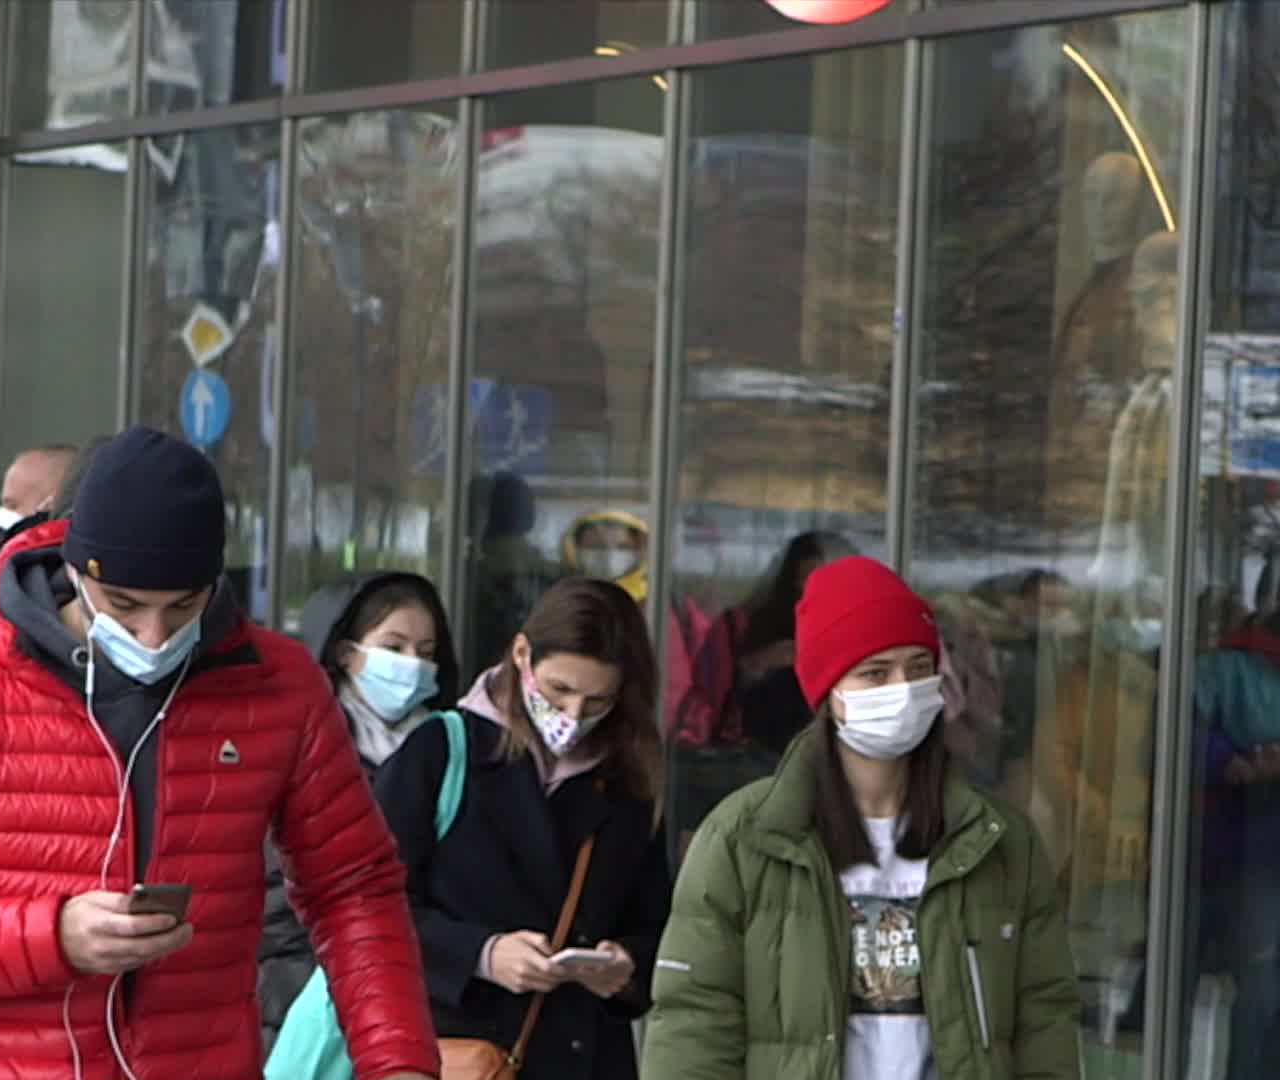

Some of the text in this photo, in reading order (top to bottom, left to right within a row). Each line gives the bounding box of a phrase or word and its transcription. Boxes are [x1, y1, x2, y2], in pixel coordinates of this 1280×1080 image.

[852, 927, 917, 948] E NOT
[854, 946, 921, 968] O WEA
